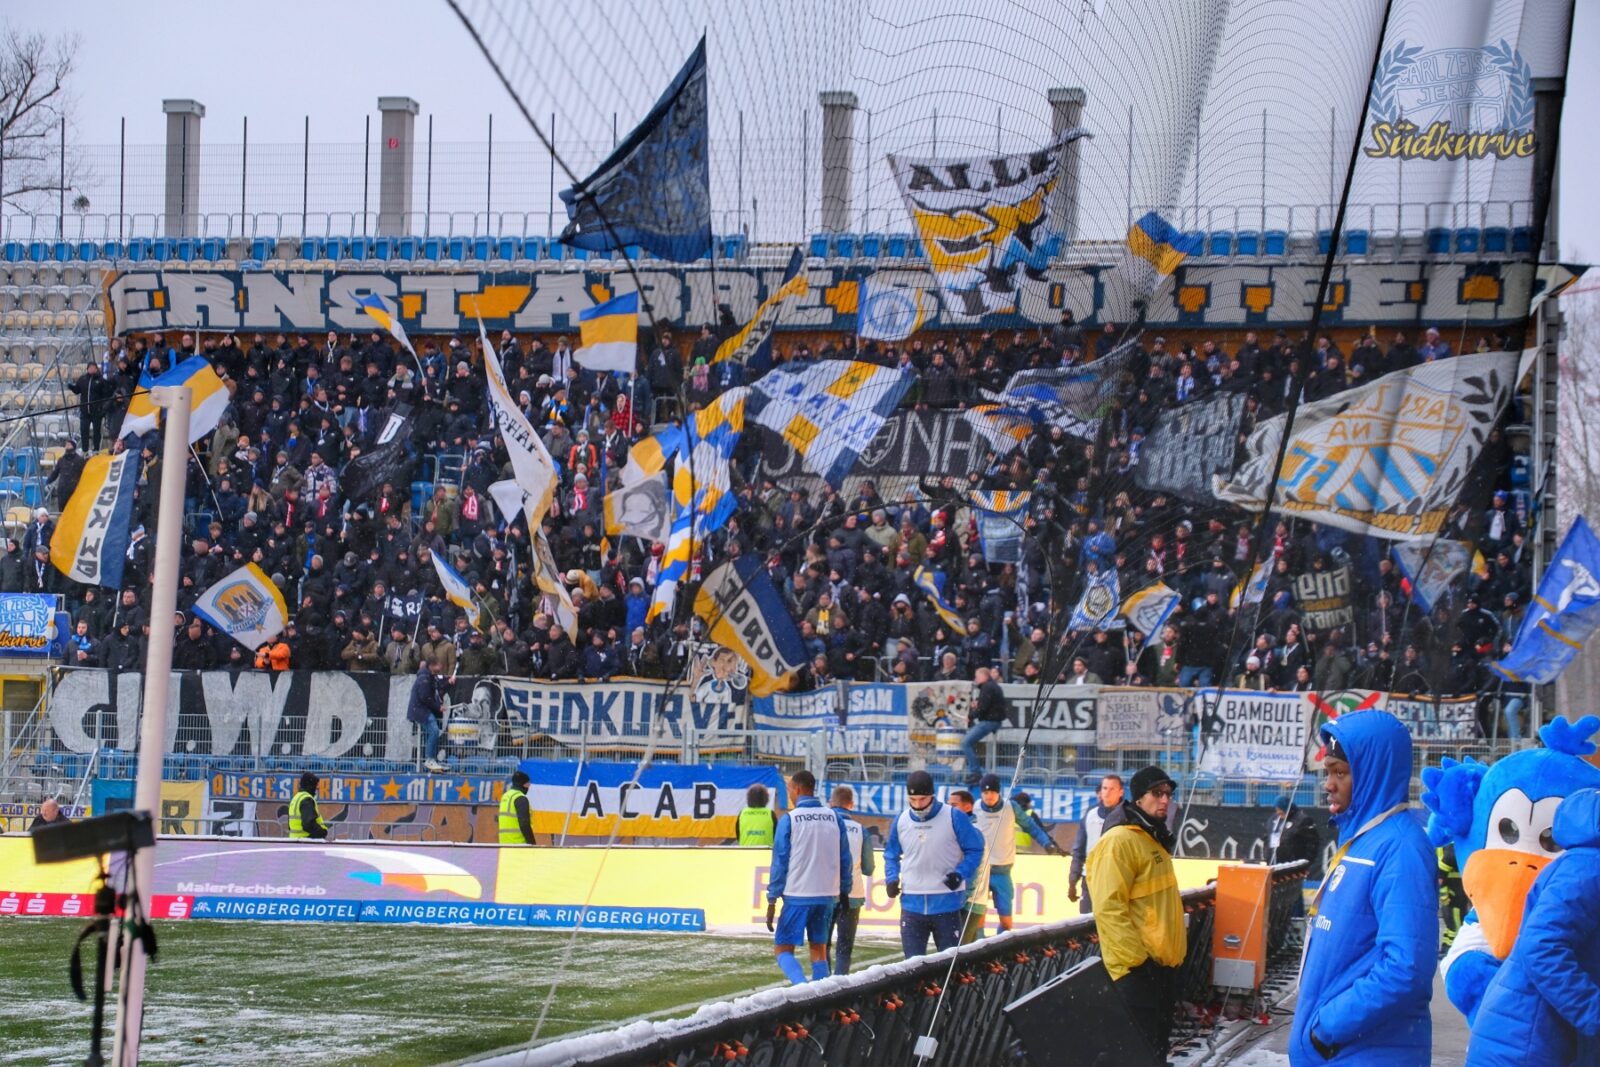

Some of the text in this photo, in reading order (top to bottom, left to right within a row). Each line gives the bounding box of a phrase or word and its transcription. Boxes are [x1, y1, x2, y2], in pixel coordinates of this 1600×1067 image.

[1417, 82, 1484, 105] JENA
[1365, 119, 1538, 161] Südkurve
[112, 270, 479, 335] ERNST
[515, 272, 833, 328] ABBE
[1106, 704, 1144, 713] SPIEL
[1226, 700, 1304, 723] BAMBULE
[1110, 721, 1141, 731] DEIN
[1225, 722, 1304, 747] RANDALE
[407, 778, 453, 801] MIT
[794, 812, 836, 823] macron
[215, 902, 357, 918] RINGBERG HOTEL
[384, 905, 527, 921] RINGBERG HOTEL
[555, 909, 701, 927] RINGBERG HOTEL
